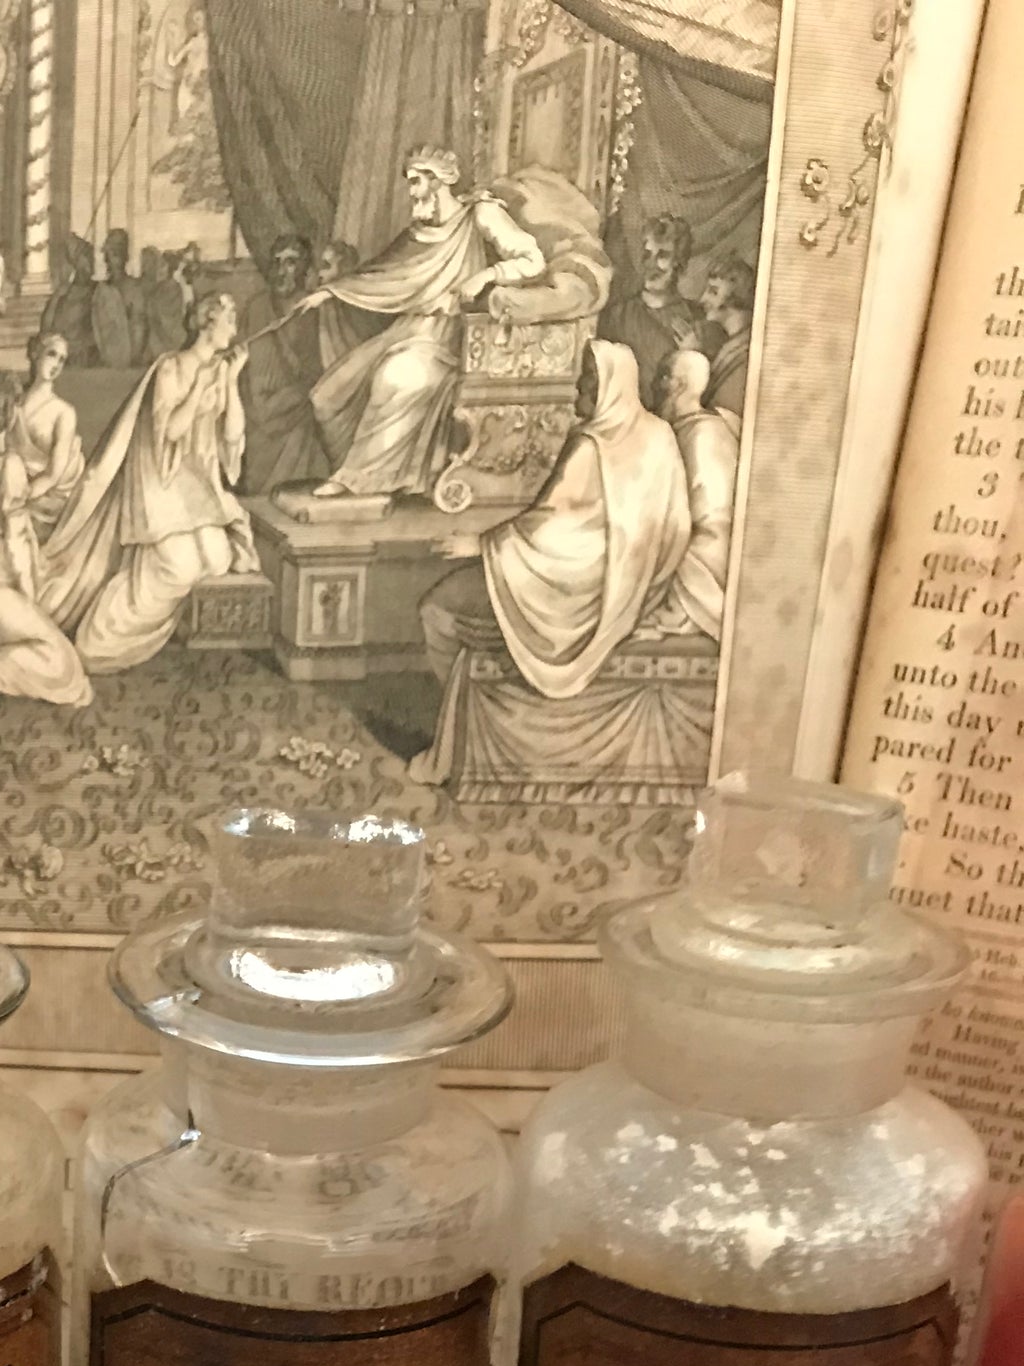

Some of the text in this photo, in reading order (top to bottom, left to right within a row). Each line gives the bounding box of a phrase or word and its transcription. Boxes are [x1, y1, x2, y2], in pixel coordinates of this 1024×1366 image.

[962, 385, 1005, 417] his
[953, 426, 1001, 458] the
[977, 471, 999, 499] 3
[933, 504, 1007, 543] thou,
[922, 553, 1022, 581] quest?
[912, 579, 1020, 618] half of
[935, 623, 956, 651] 4
[893, 663, 1017, 697] unto the
[883, 691, 933, 724] this
[946, 700, 1001, 740] day
[871, 736, 1012, 772] pared for
[936, 772, 1012, 811] Then
[942, 811, 1024, 852] haste,
[944, 853, 984, 881] So
